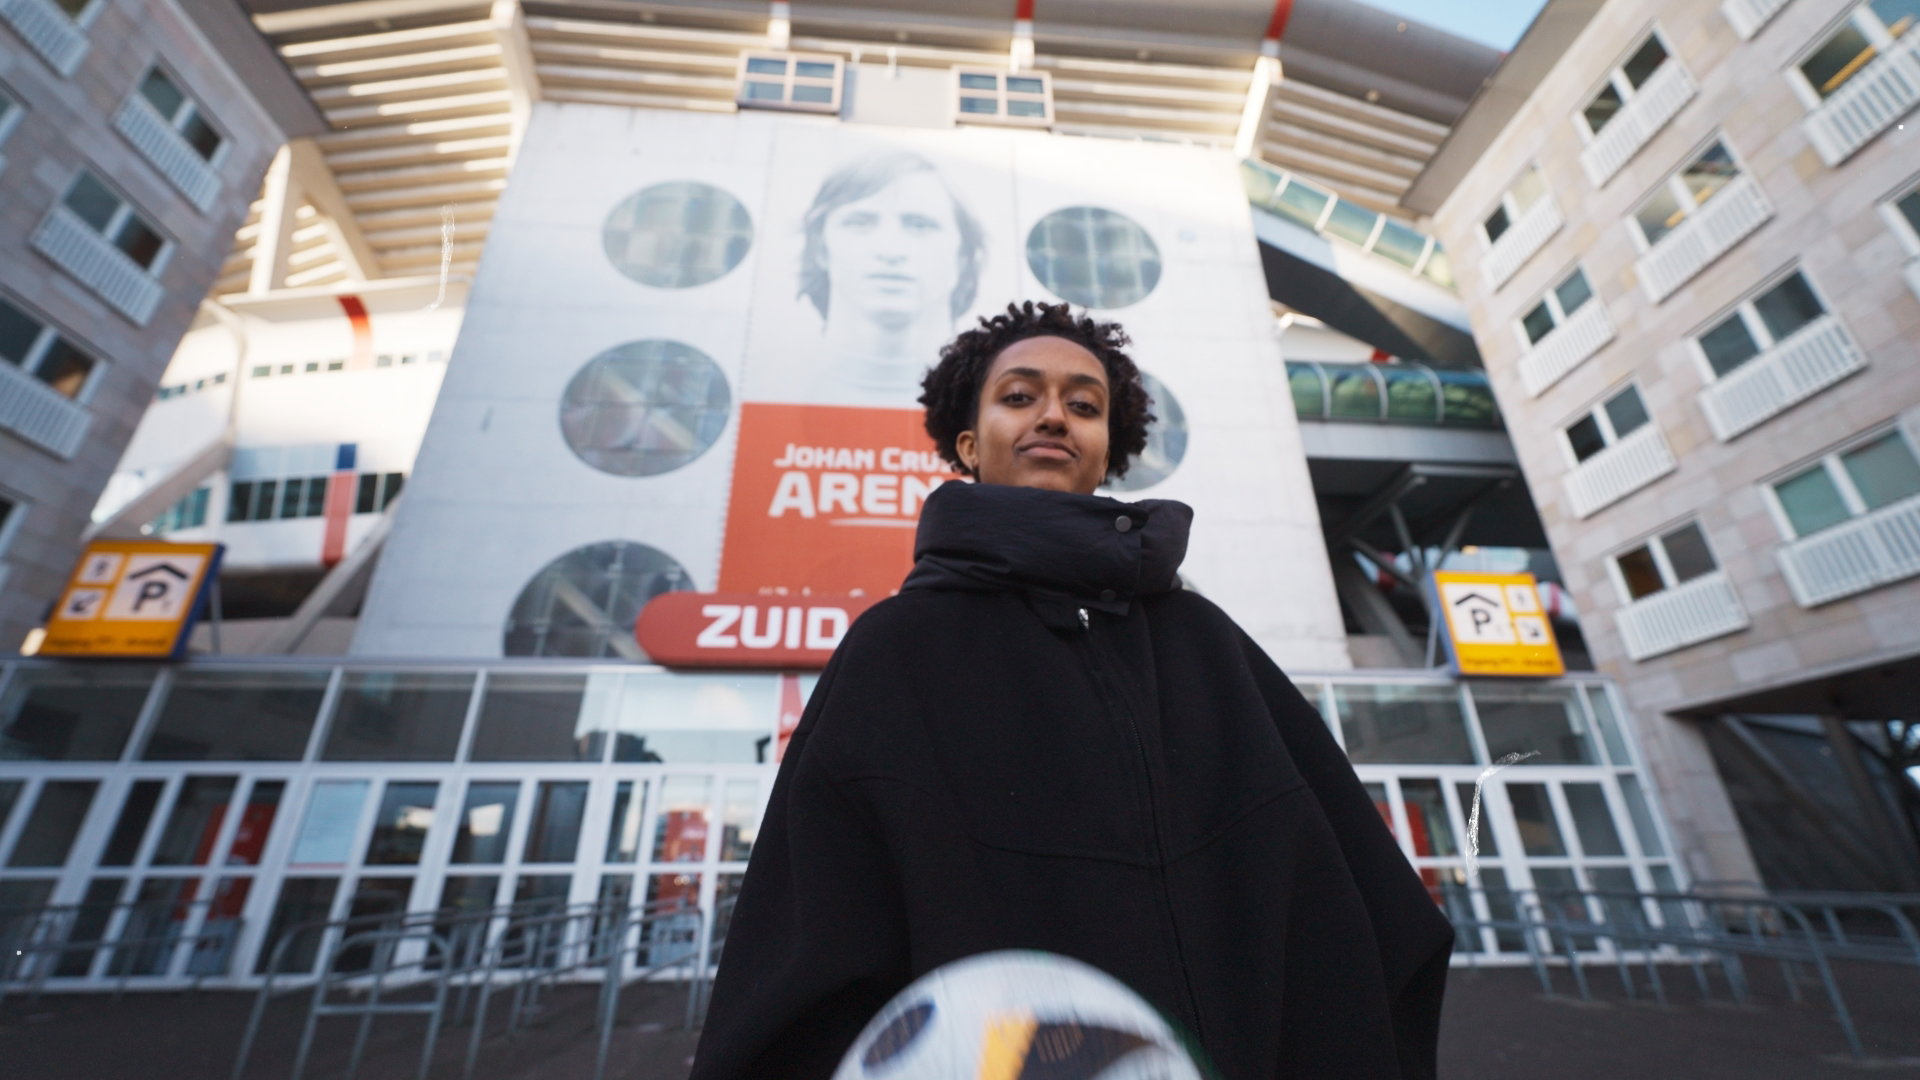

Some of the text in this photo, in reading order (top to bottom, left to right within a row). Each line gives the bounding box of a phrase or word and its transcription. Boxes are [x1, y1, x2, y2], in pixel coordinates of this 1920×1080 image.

[767, 471, 975, 519] AREN
[131, 581, 168, 612] P
[696, 604, 849, 650] ZUID
[1469, 608, 1492, 635] P
